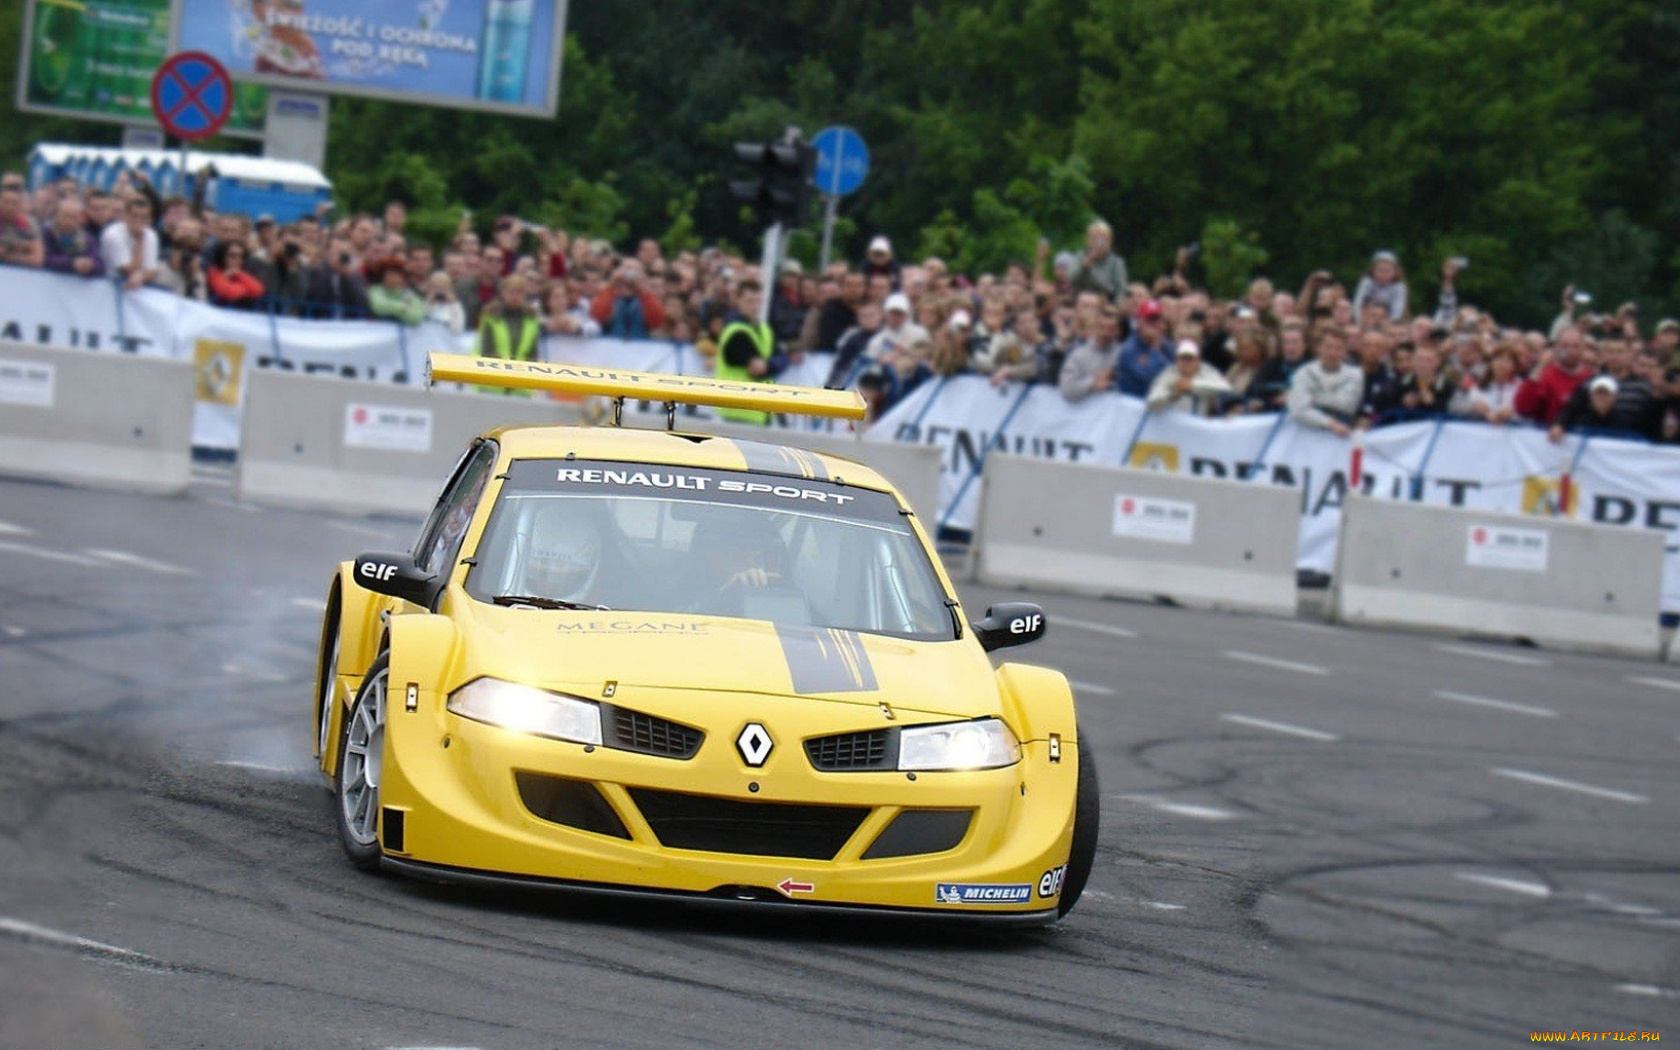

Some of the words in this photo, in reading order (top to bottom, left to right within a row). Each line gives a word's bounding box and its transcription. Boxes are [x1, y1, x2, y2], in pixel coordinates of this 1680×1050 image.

[332, 39, 373, 56] POD
[380, 26, 477, 52] OCHRONA
[477, 361, 646, 382] RENAULT
[658, 378, 809, 396] SPORT
[557, 468, 711, 490] RENAULT
[718, 480, 854, 505] SPORT
[360, 561, 398, 580] elf
[1010, 614, 1041, 634] elf
[964, 887, 1030, 899] MICHELIN
